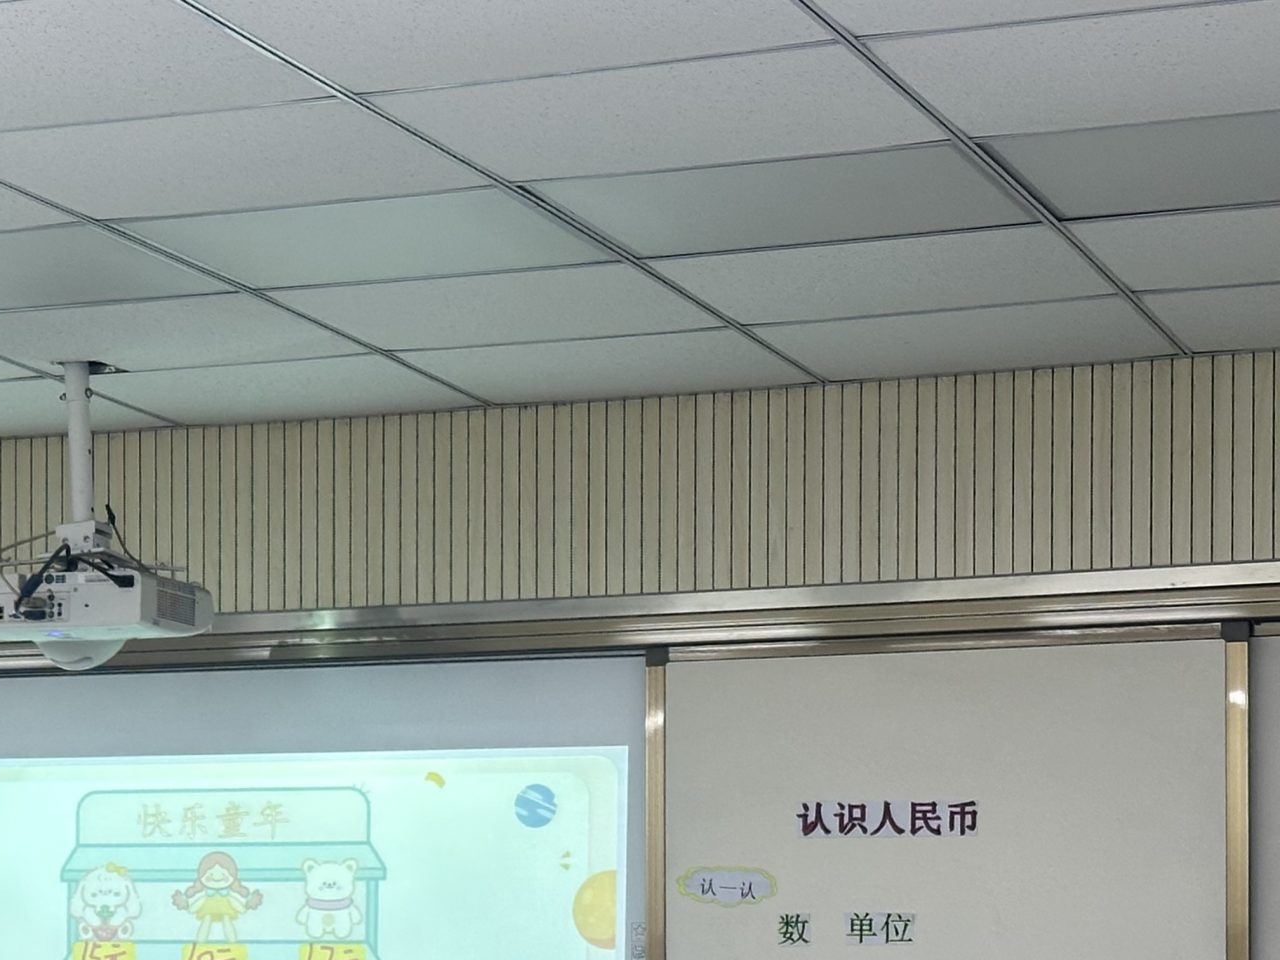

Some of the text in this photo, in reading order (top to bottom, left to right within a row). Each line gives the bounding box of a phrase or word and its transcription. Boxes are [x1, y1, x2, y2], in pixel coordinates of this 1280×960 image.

[137, 801, 290, 841] 快乐童年
[796, 801, 978, 837] 认识人民币
[700, 877, 755, 900] 认一认
[778, 913, 913, 944] 数 单位
